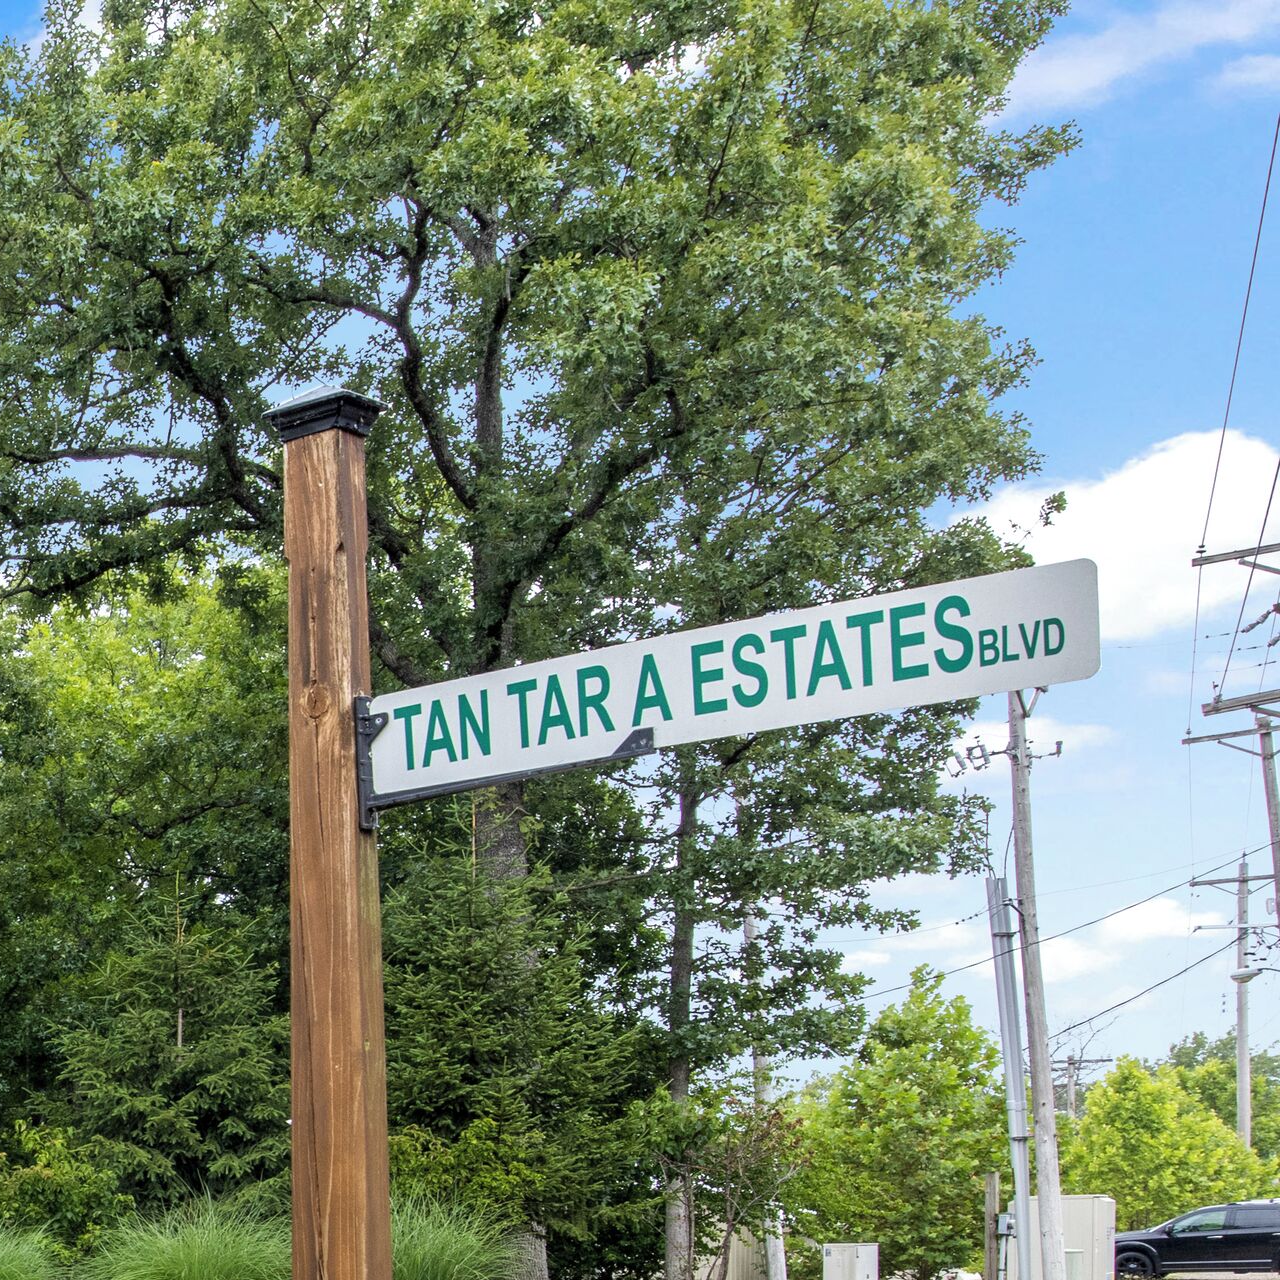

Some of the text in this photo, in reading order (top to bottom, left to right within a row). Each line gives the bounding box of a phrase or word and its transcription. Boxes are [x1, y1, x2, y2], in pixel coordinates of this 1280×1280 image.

[393, 594, 1066, 770] TAN TAR A ESTATES BLVD
